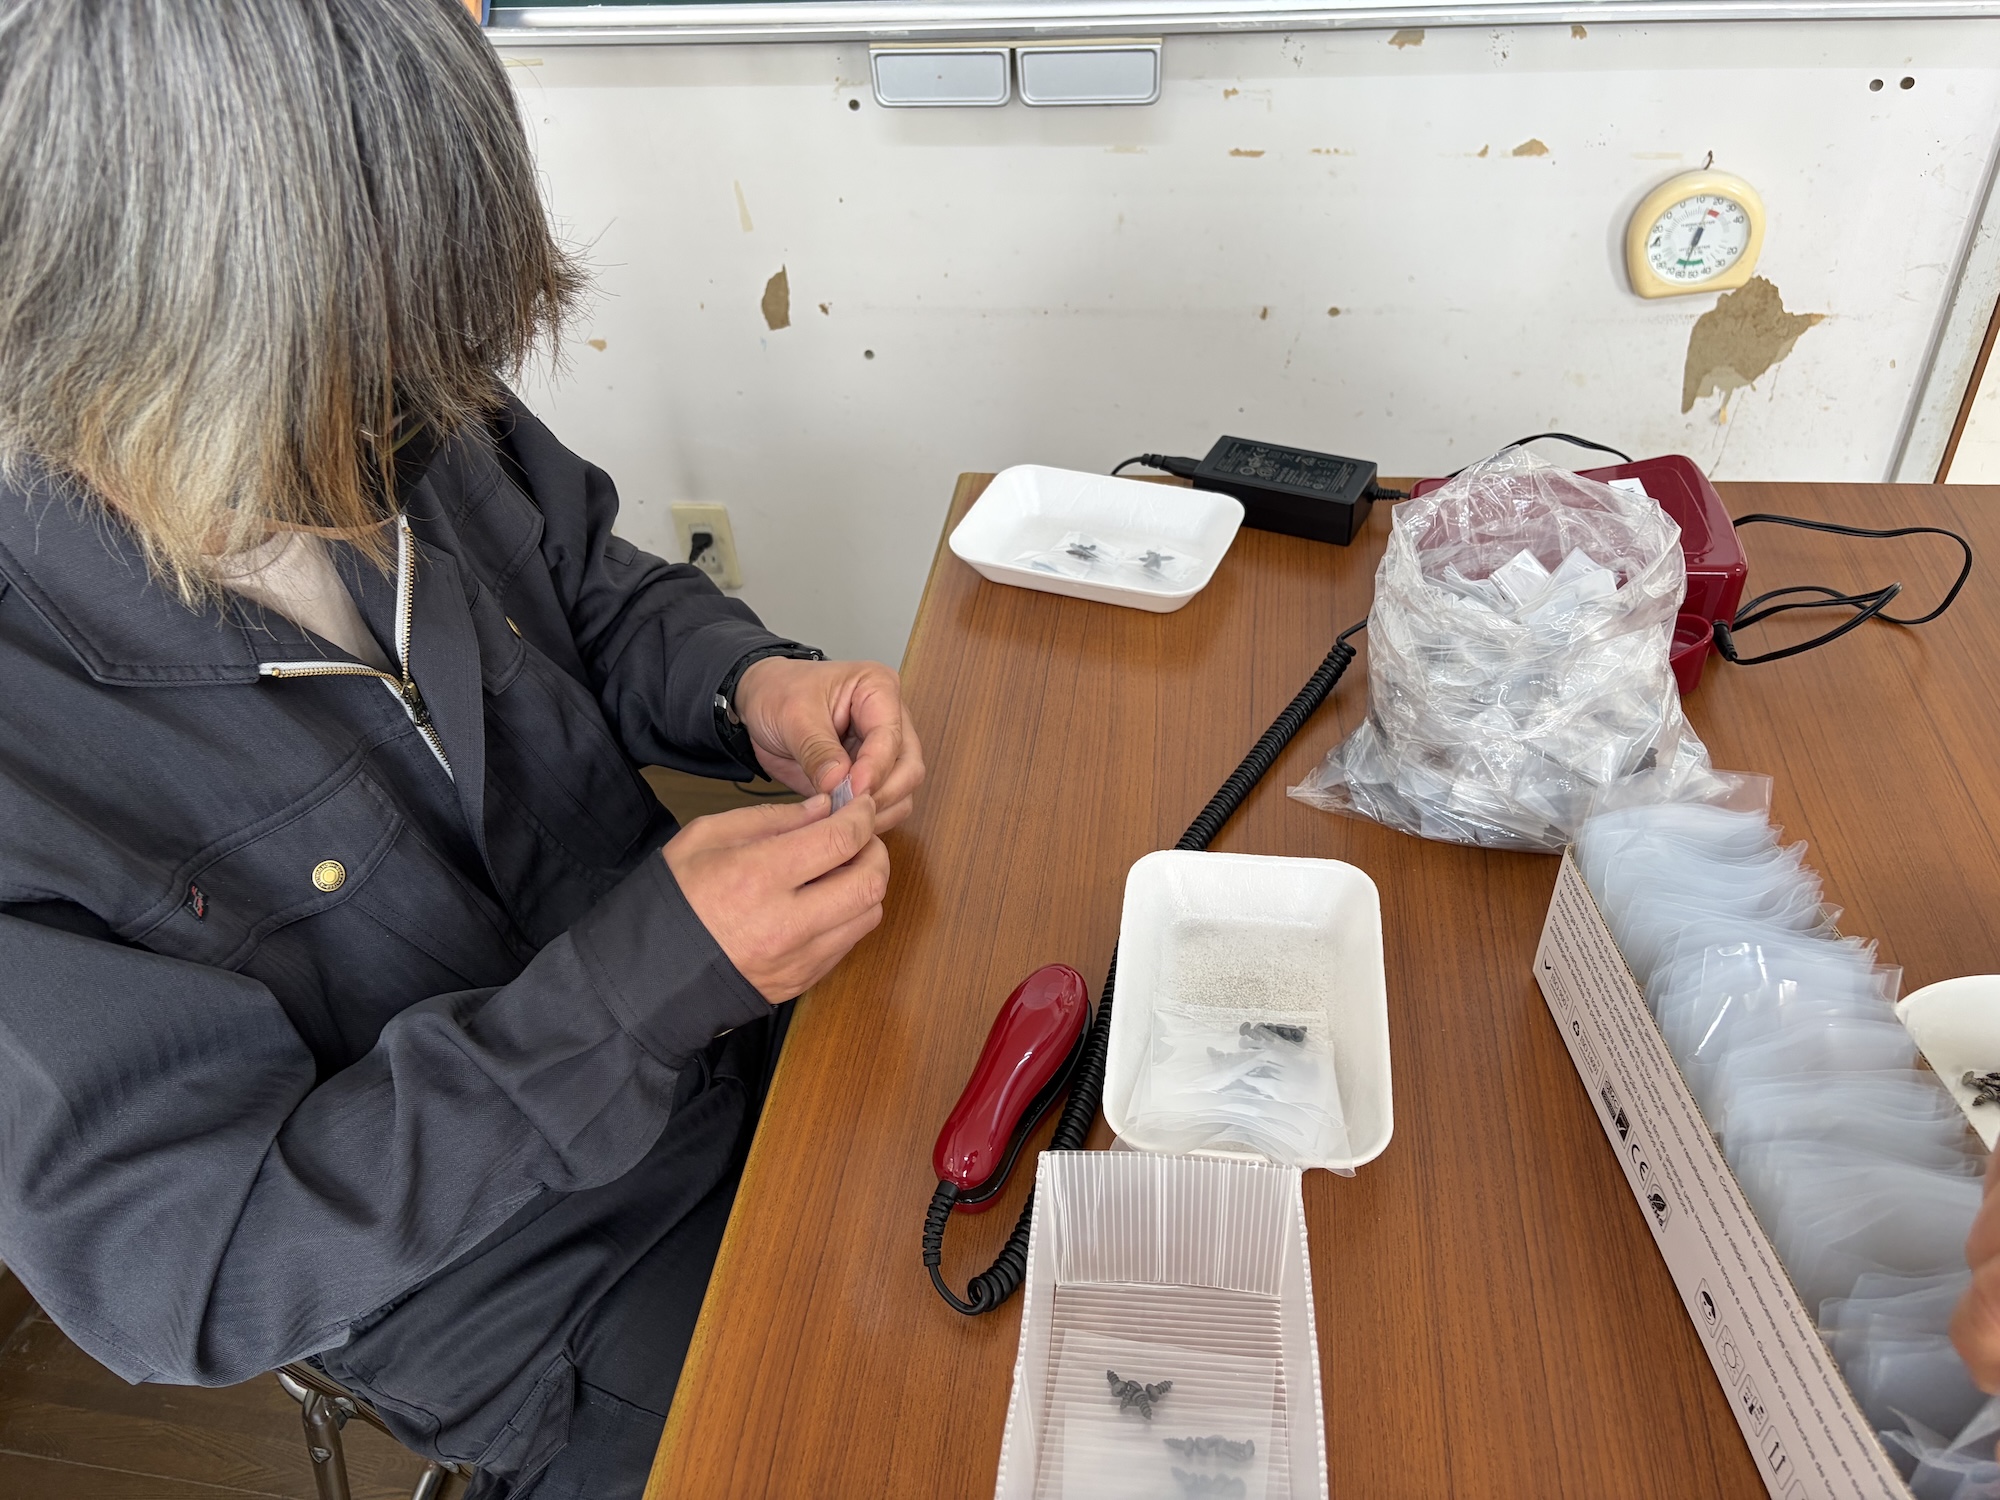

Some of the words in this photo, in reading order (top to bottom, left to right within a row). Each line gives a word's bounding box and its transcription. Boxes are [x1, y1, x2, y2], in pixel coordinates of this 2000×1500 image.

[1568, 949, 1586, 988] cartuchos
[1585, 985, 1591, 999] de
[1659, 1138, 1666, 1155] de
[1665, 1151, 1684, 1192] garantir
[1683, 1189, 1694, 1214] uma
[1720, 1264, 1735, 1298] limpa
[1734, 1295, 1740, 1306] e
[1756, 1337, 1778, 1385] Guarde
[1777, 1382, 1786, 1401] os
[1785, 1398, 1816, 1462] cartuchos
[1814, 1458, 1825, 1480] de
[1580, 934, 1599, 974] cartuchos
[1597, 970, 1604, 984] de
[1613, 1001, 1635, 1049] protegidos
[1634, 1043, 1640, 1059] de
[1639, 1055, 1645, 1068] la
[1644, 1064, 1652, 1082] luz
[1650, 1078, 1662, 1103] para
[1683, 1144, 1709, 1199] resultados
[1708, 1194, 1725, 1230] claros
[1723, 1227, 1729, 1240] y
[1747, 1271, 1777, 1332] Almacene
[1775, 1328, 1786, 1350] los
[1784, 1346, 1815, 1408] cartuchos
[1814, 1404, 1824, 1426] de
[1584, 996, 1590, 1011] de
[1584, 902, 1588, 914] le
[1587, 911, 1604, 946] cartucce
[1603, 942, 1608, 955] di
[1607, 951, 1619, 976] toner
[1628, 992, 1638, 1014] luce
[1636, 1011, 1645, 1029] per
[1680, 1098, 1686, 1112] di
[1685, 1108, 1705, 1149] stampa
[1718, 1172, 1751, 1239] Conservare
[1750, 1235, 1758, 1250] le
[1757, 1246, 1783, 1300] cartucce
[1782, 1295, 1790, 1312] di
[1789, 1309, 1806, 1344] toner
